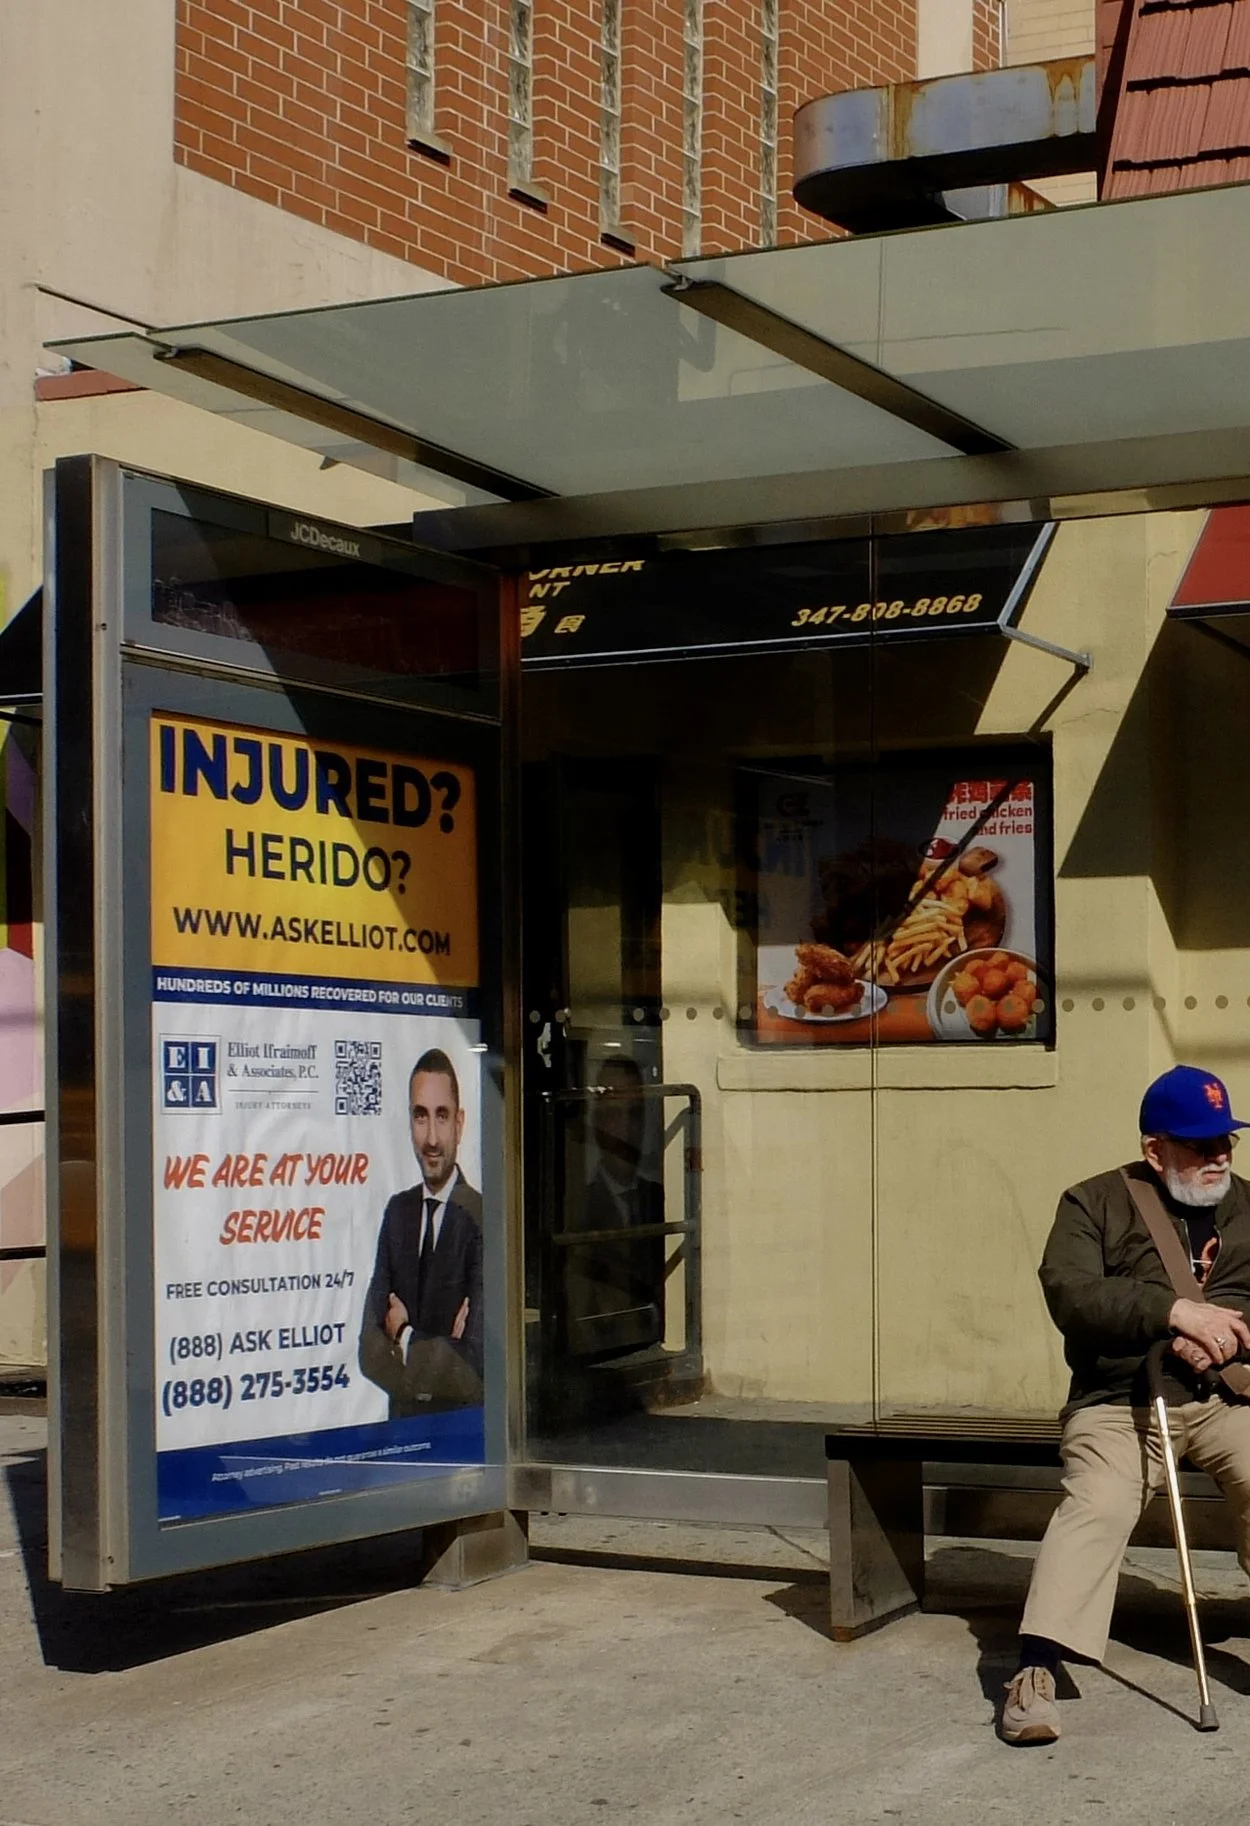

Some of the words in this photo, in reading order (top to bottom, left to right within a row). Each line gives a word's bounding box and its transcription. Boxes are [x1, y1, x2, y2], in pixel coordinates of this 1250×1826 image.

[290, 521, 360, 558] JCDecaux
[790, 593, 983, 627] 347-808-8868
[160, 724, 460, 834] INJURED?
[1000, 821, 1033, 834] fries
[225, 828, 411, 894] HERIDO?
[173, 907, 451, 957] WWW.ASKELLIOT.COM
[157, 976, 231, 995] HUNDREDS
[234, 982, 250, 995] OF
[253, 983, 308, 999] MILLIONS
[311, 986, 377, 1002] RECOVERED
[379, 989, 399, 1003] FOR
[402, 991, 424, 1006] OUR
[426, 993, 464, 1008] CLIENTS
[228, 1042, 260, 1059] Elliot
[228, 1064, 238, 1078] &
[299, 1065, 319, 1079] P.C.
[163, 1154, 210, 1190] WE
[211, 1153, 268, 1188] ARE
[269, 1153, 304, 1187] AT
[304, 1153, 369, 1186] YOUR
[219, 1207, 325, 1246] SERVICE
[166, 1282, 202, 1299] FREE
[207, 1274, 321, 1297] CONSULTATION
[325, 1269, 354, 1288] 24/7
[169, 1333, 223, 1365] (888)
[229, 1329, 273, 1354] ASK
[279, 1323, 346, 1350] ELLIOT
[162, 1375, 232, 1417] (888)
[240, 1363, 351, 1401] 275-3554
